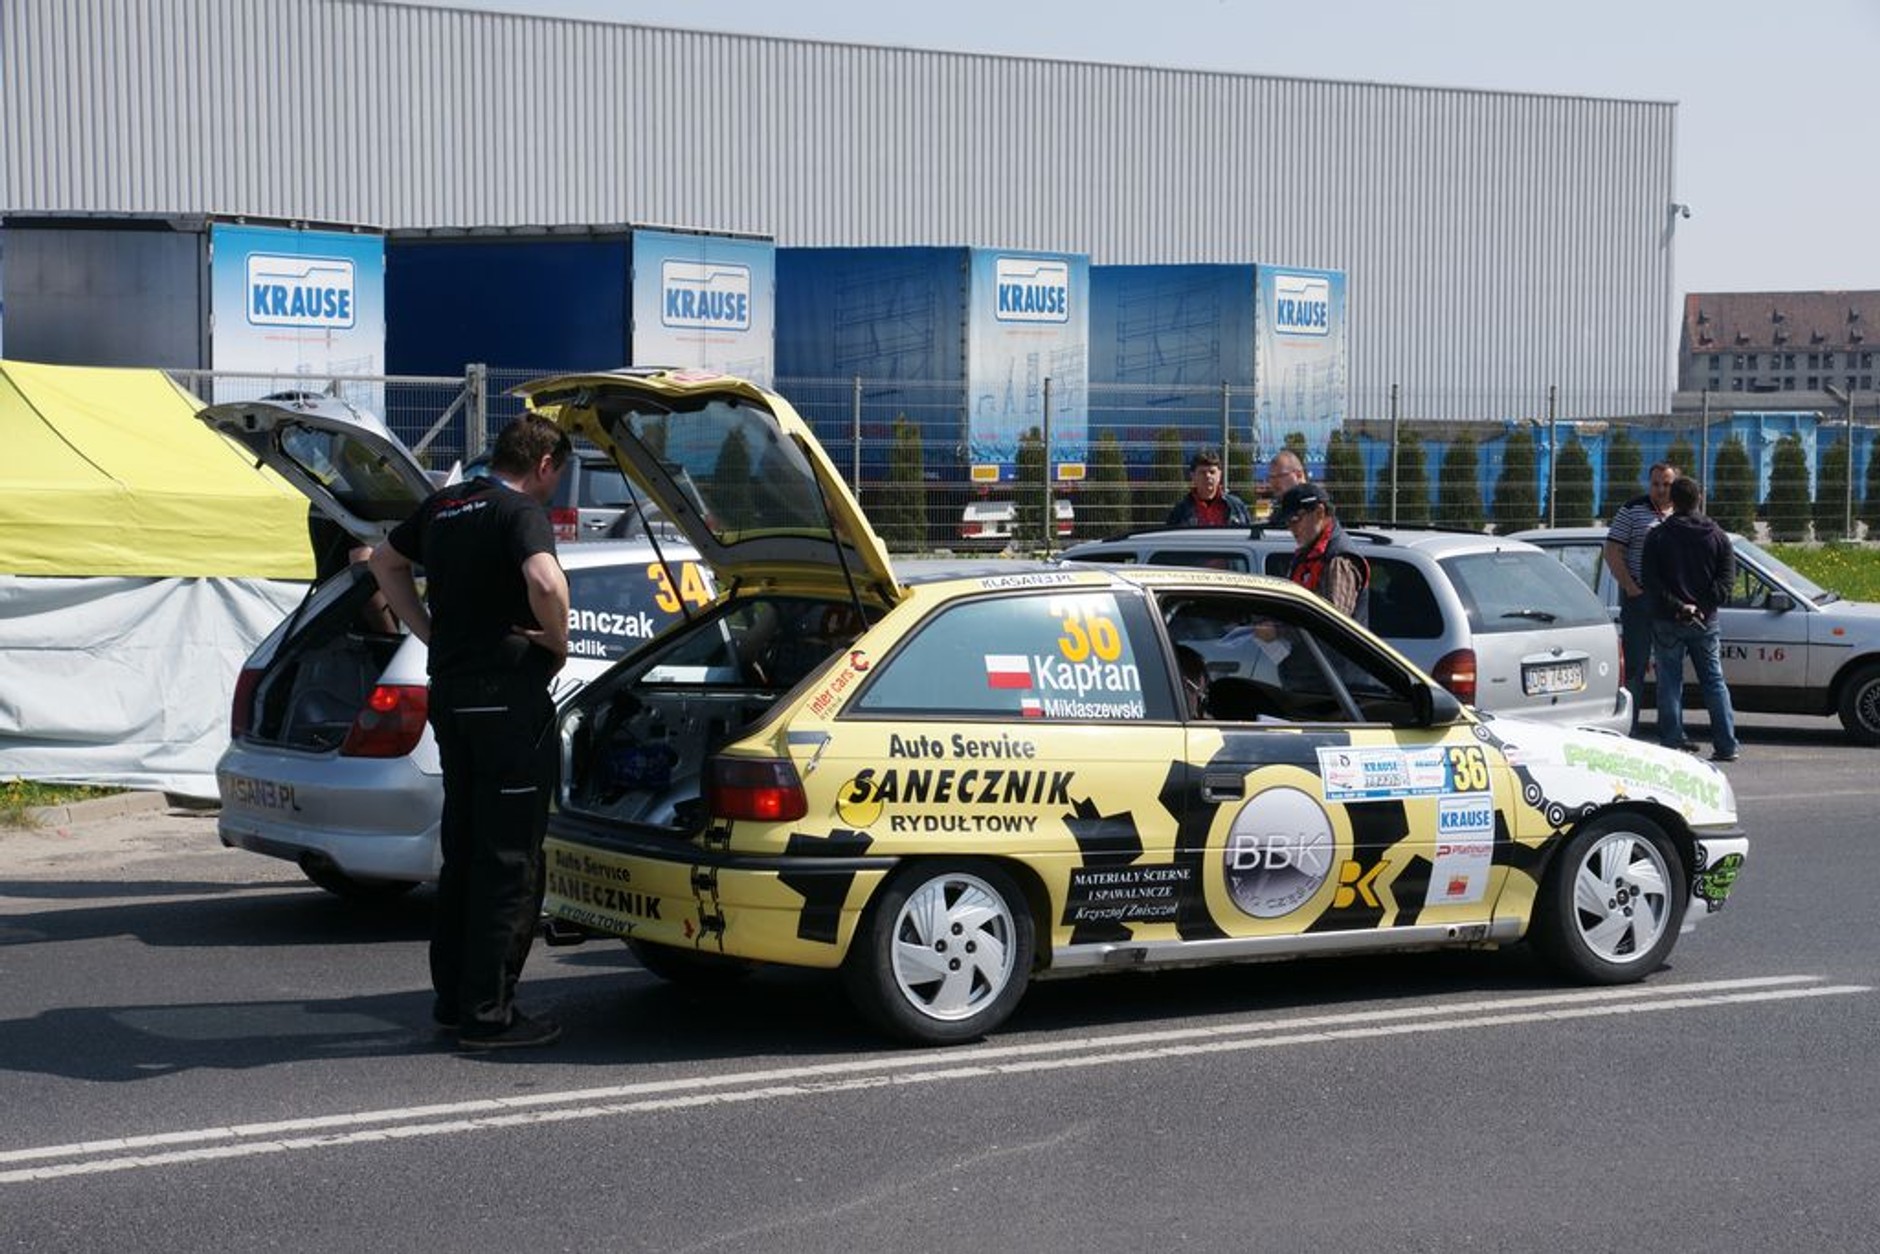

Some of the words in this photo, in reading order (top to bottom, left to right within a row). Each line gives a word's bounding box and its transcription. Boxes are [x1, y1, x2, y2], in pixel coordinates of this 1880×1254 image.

[253, 283, 350, 319] KRAUSE
[666, 287, 747, 322] KRAUSE
[999, 283, 1065, 314] KRAUSE
[1277, 299, 1327, 327] KRAUSE
[647, 560, 711, 613] 34
[568, 608, 654, 638] anczak
[1051, 598, 1121, 662] 36
[567, 639, 607, 657] adlik
[809, 689, 834, 716] inter
[831, 669, 855, 693] cars
[1034, 654, 1141, 698] Kapłan
[1044, 699, 1144, 719] Miklaszewski
[889, 733, 944, 759] Auto
[952, 733, 1036, 759] Service
[1449, 747, 1489, 791] 36
[848, 768, 1076, 805] SANECZNIK
[892, 815, 1038, 832] RYDUŁTOWY
[1441, 810, 1491, 828] KRAUSE
[556, 849, 582, 872] Auto
[584, 855, 631, 882] Service
[1232, 834, 1325, 870] BBK
[550, 872, 662, 920] SANECZNIK
[1095, 886, 1172, 900] SPAWALNICZE
